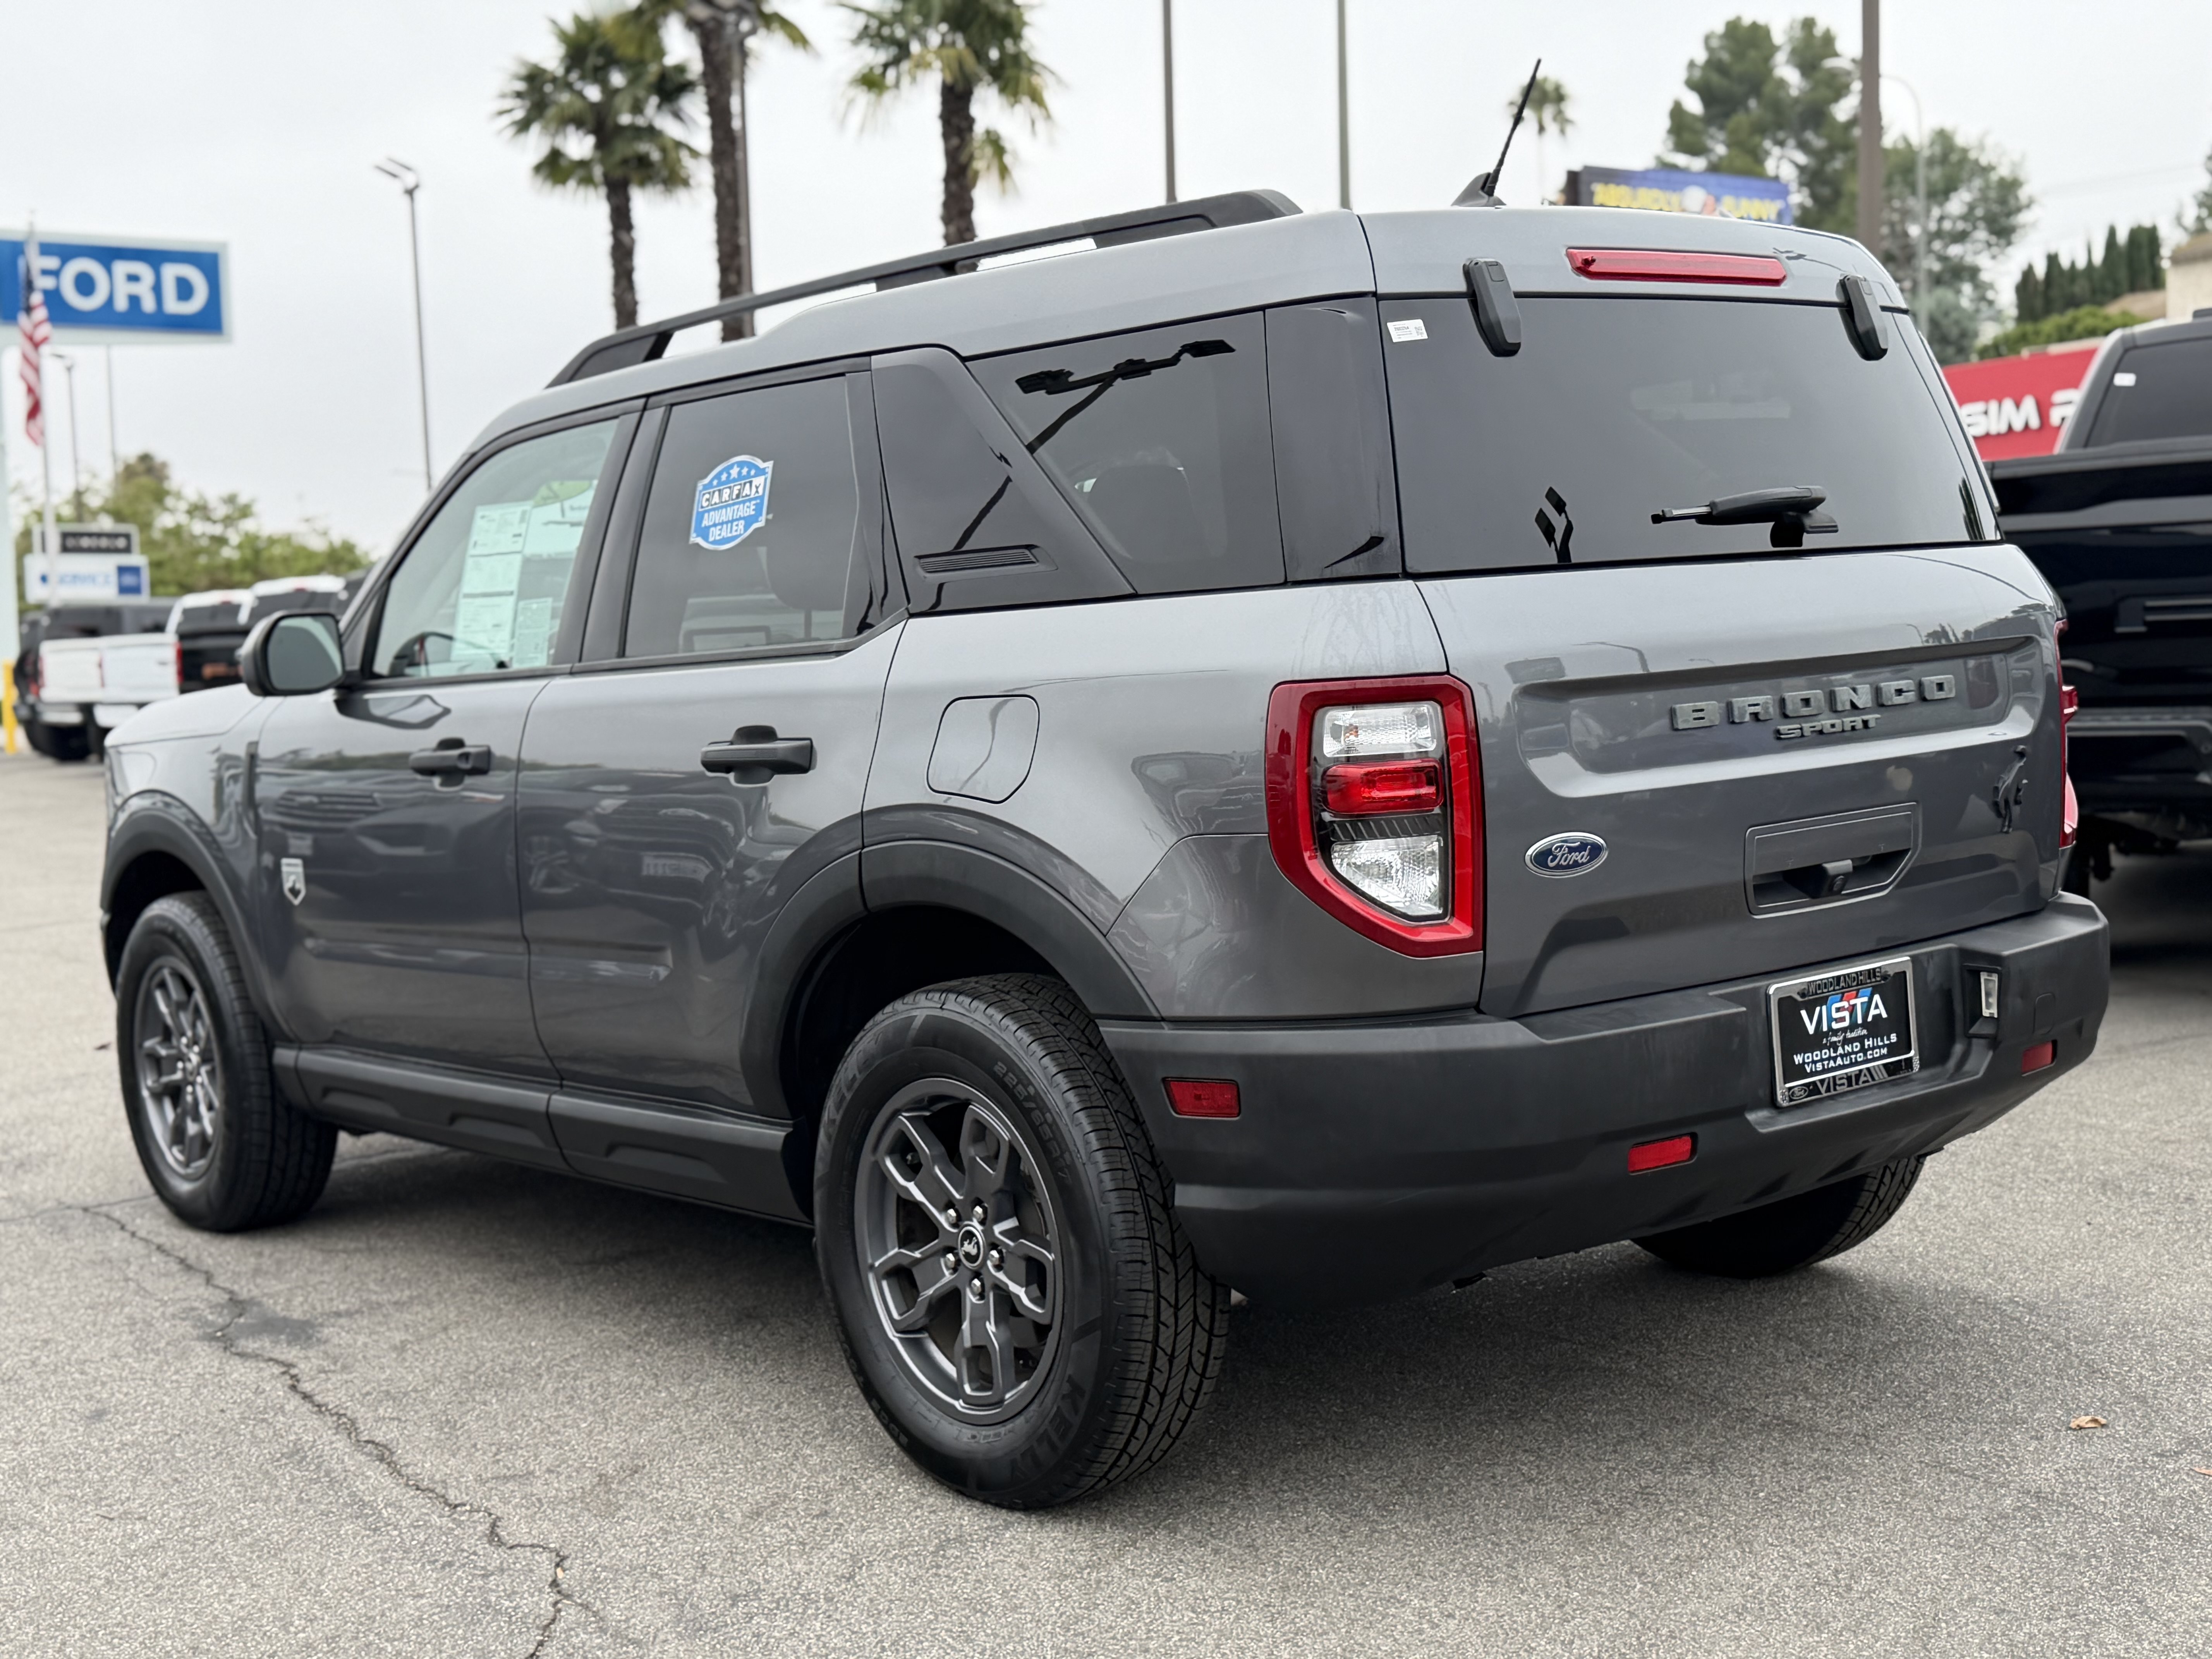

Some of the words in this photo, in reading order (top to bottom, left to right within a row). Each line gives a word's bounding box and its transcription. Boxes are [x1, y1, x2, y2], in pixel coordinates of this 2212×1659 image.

[17, 254, 210, 316] FORD
[701, 481, 763, 507] CARFAX
[701, 501, 756, 527] ADVANTAGE
[709, 520, 745, 542] DEALER
[1672, 675, 1955, 730] BRONCO
[1776, 714, 1881, 740] SPORT
[1547, 842, 1591, 867] Ford
[1808, 973, 1857, 995] WOODLAND
[1858, 968, 1882, 985] HILLS
[1800, 993, 1888, 1035] VISTA
[1793, 1042, 1860, 1065] WOODLAND
[1865, 1033, 1897, 1049] HILLS
[1815, 1066, 1872, 1095] VISTA
